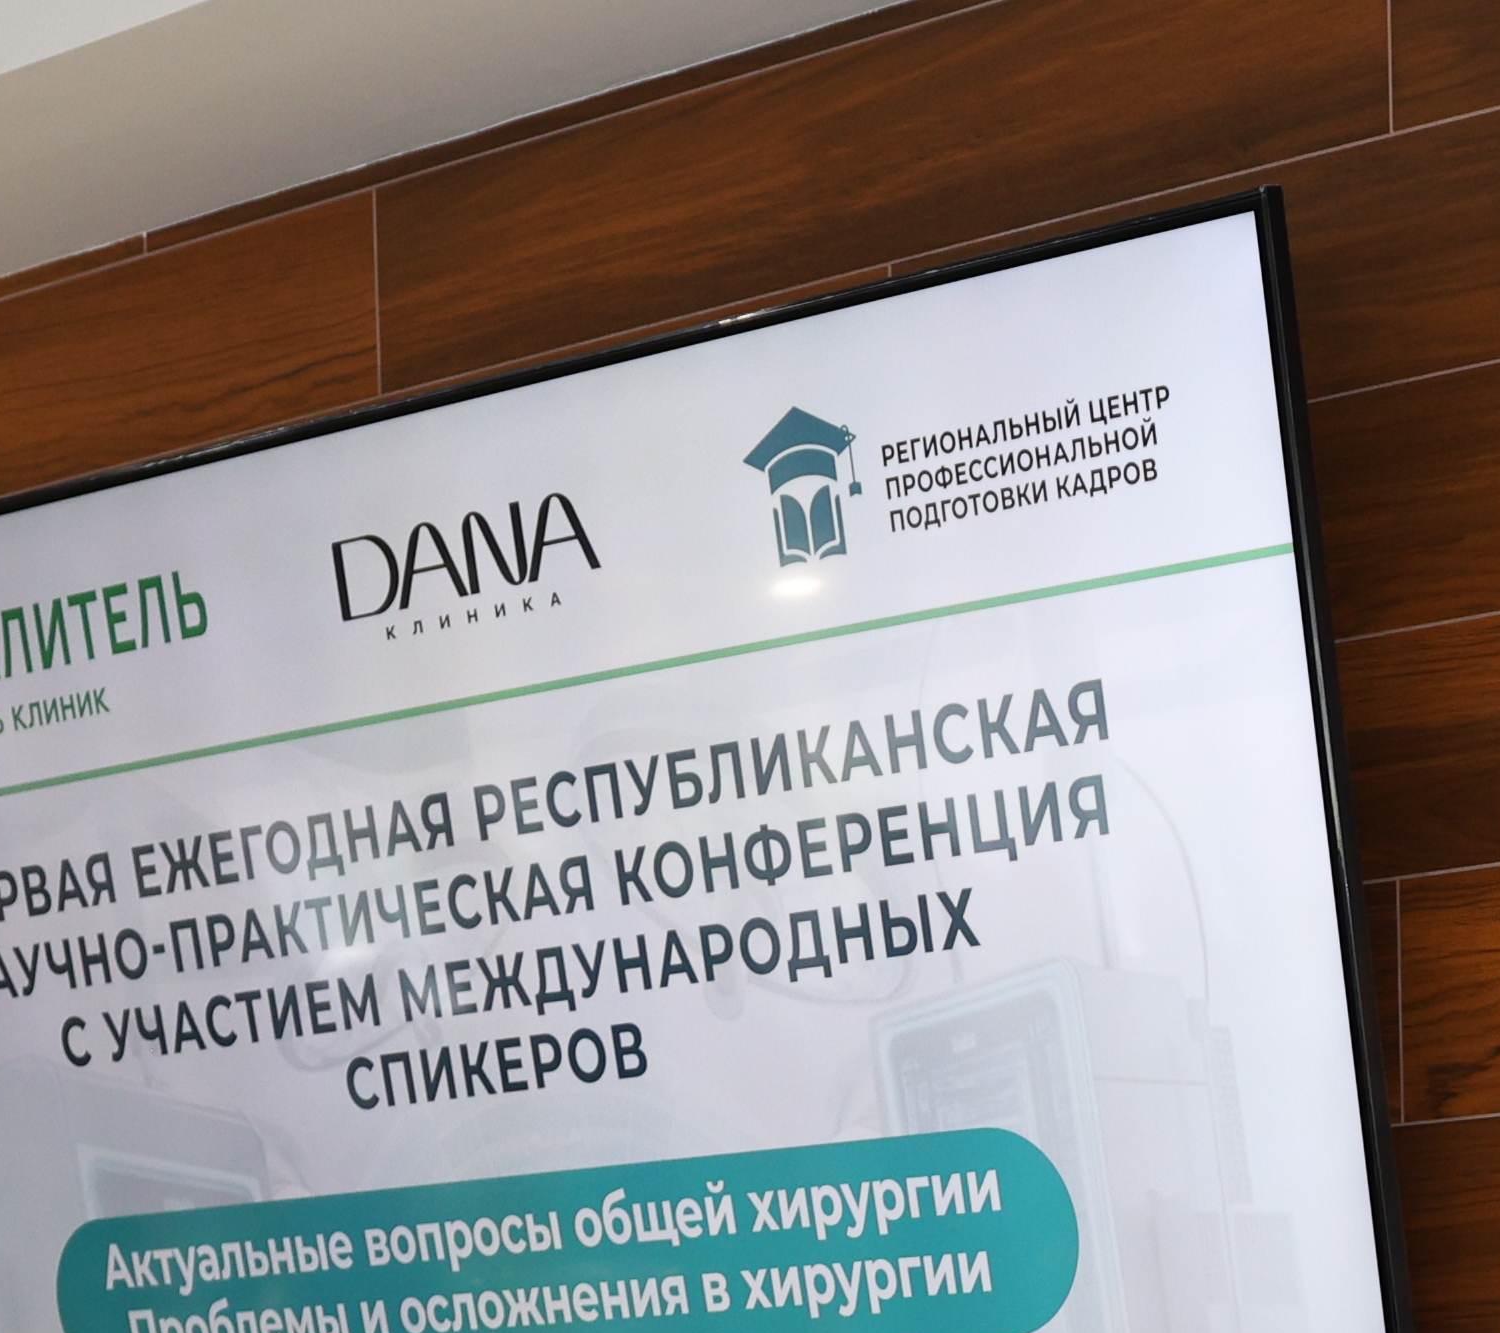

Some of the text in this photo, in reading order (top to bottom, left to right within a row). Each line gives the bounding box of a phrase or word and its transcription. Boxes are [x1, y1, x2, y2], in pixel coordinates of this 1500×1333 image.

[880, 384, 1171, 467] РЕГИОНАЛЬНЫЙ ЦЕНТР
[885, 418, 1159, 500] ПРОФЕССИОНАЛЬНОЙ
[889, 457, 1159, 533] ПОДГОТОВКИ КАДРОВ
[331, 491, 602, 622] DANA
[384, 591, 563, 642] КЛИНИКА
[11, 686, 111, 732] КЛИНИК
[131, 791, 455, 899] ЕЖЕГОДНАЯ
[473, 678, 1110, 842] РЕСПУБЛИКАНСКАЯ
[614, 773, 1111, 907] КОНФЕРЕНЦИЯ
[61, 886, 982, 1067] С УЧАСТИЕМ МЕЖДУНАРОДНЫХ
[345, 1021, 648, 1110] СПИКЕРОВ
[104, 1168, 1003, 1297] Актуальные вопросы общей хирургии
[701, 1271, 731, 1313] в
[739, 1249, 994, 1320] хирургии
